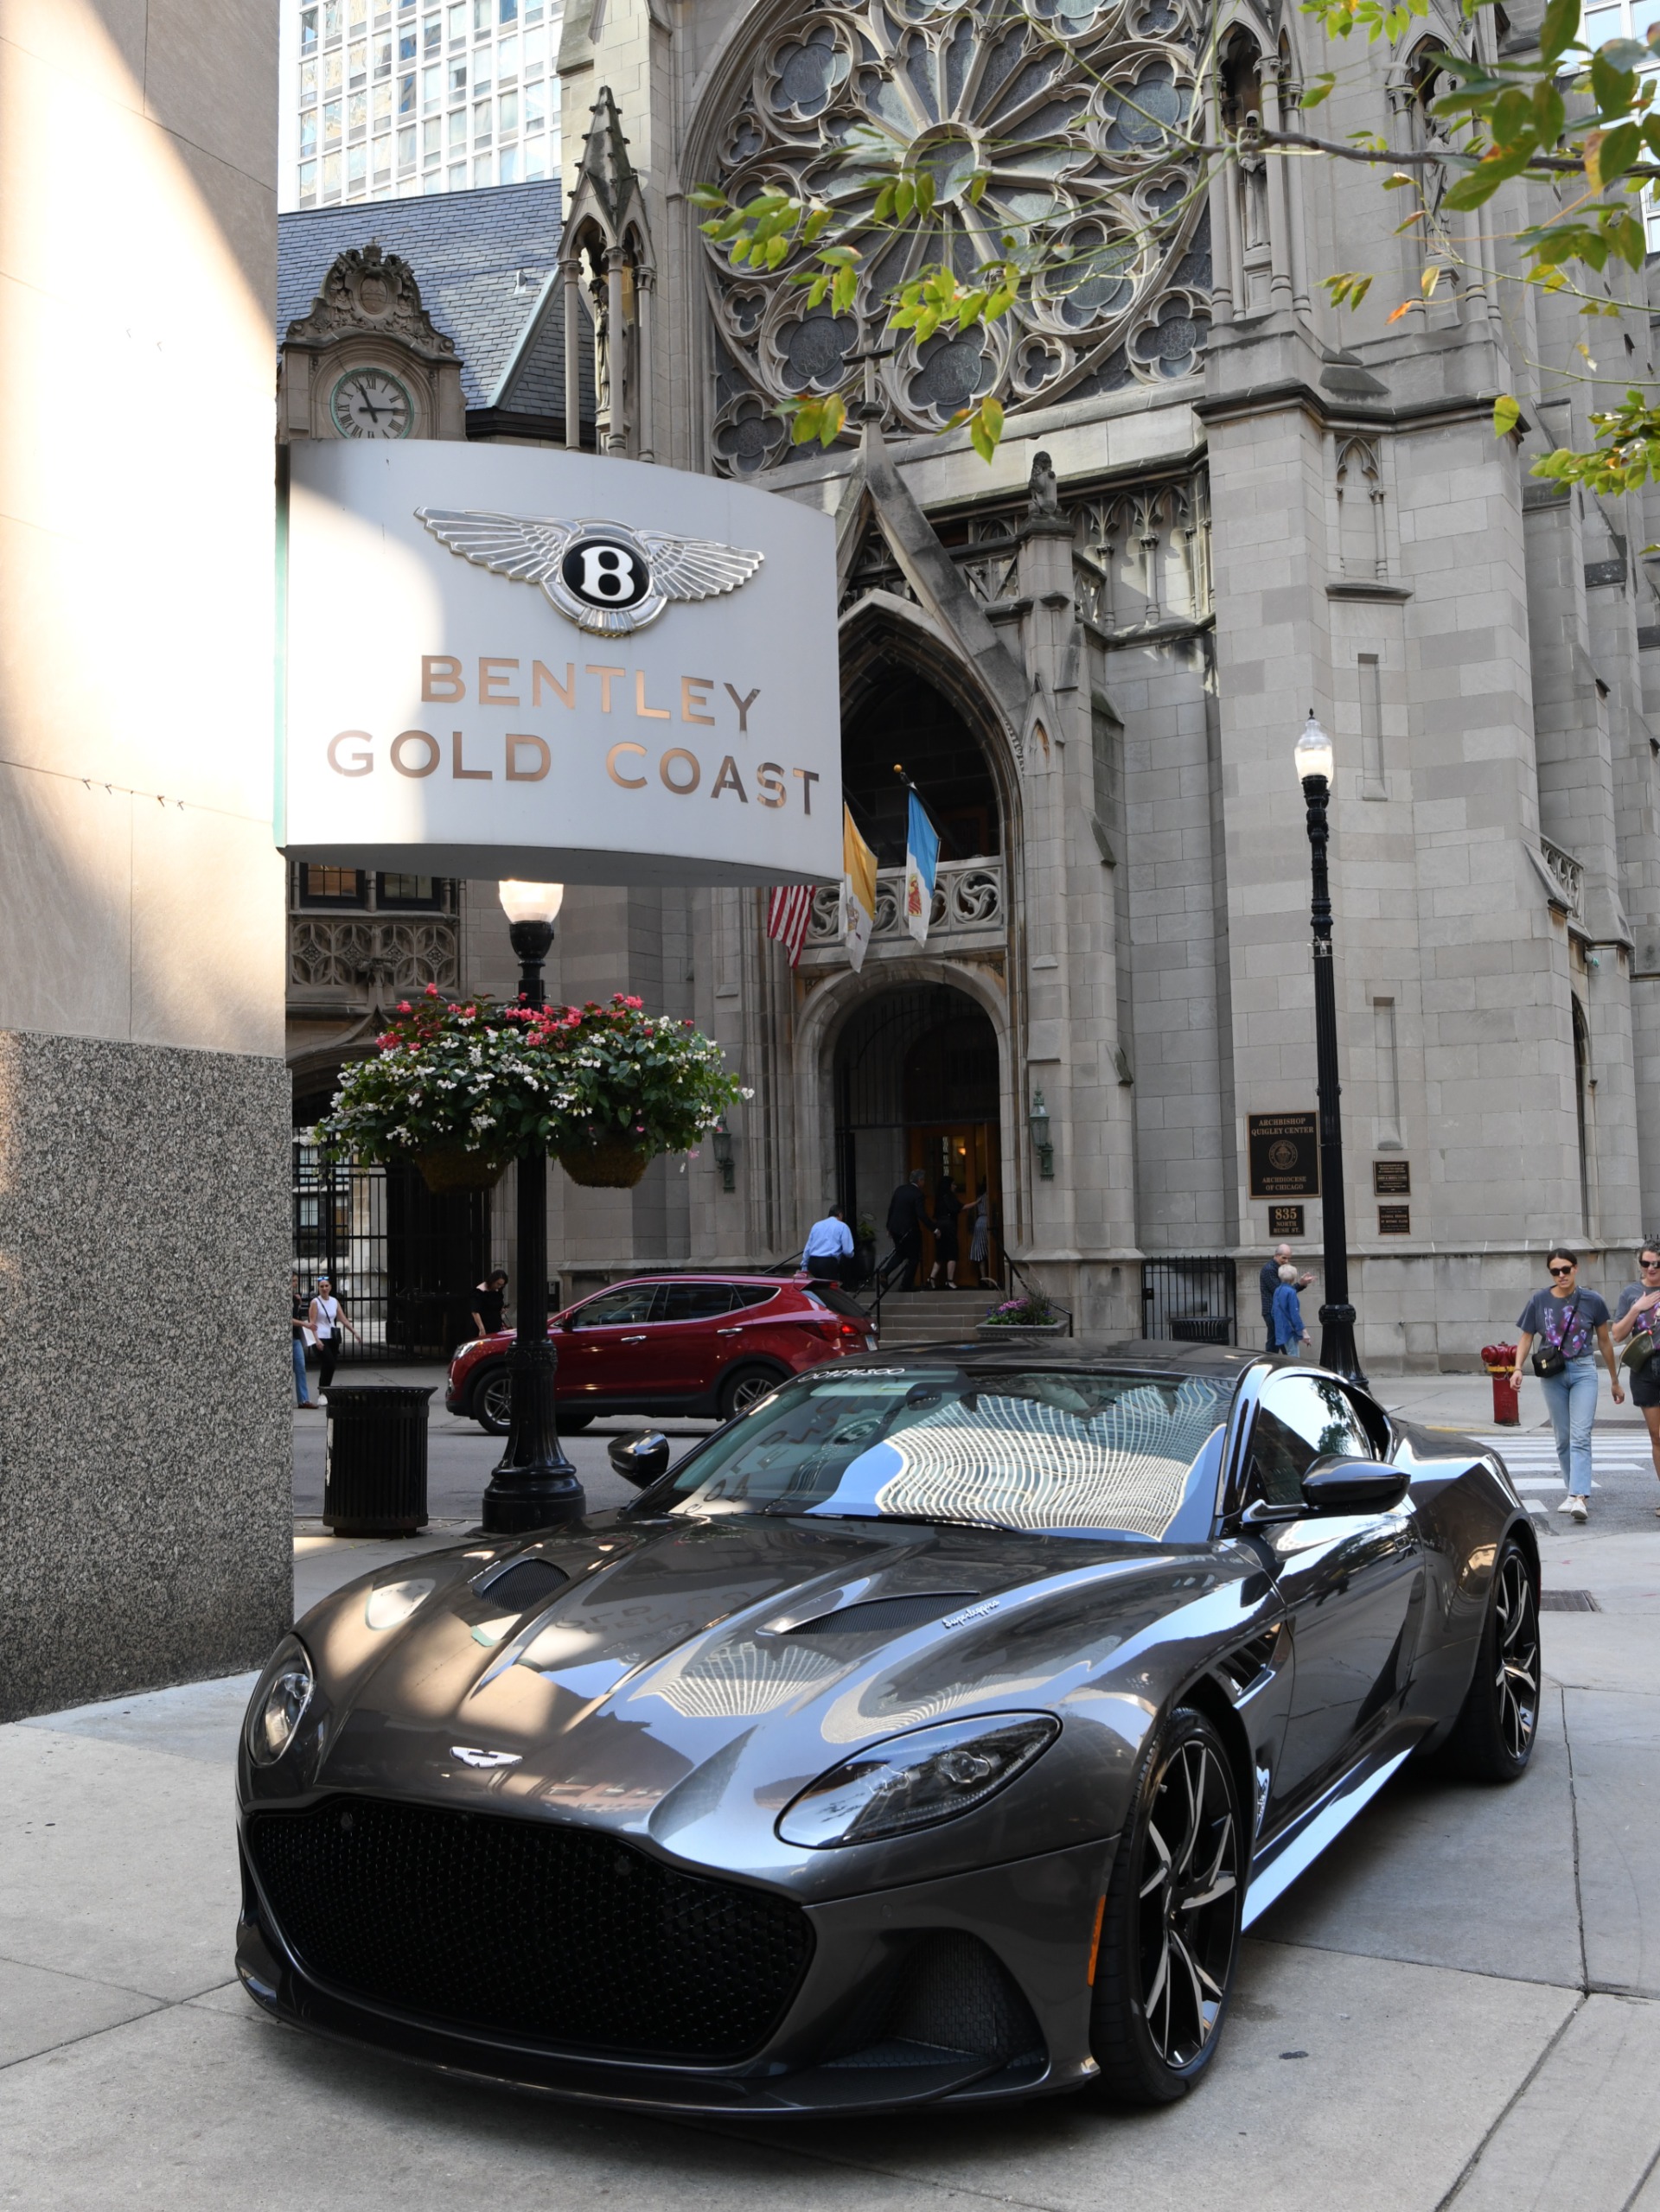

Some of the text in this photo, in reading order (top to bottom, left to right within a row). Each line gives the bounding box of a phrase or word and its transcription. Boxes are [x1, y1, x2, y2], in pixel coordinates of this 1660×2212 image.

[580, 545, 636, 602] B
[421, 654, 762, 733] BENTLEY
[326, 730, 820, 816] GOLD COAST
[1251, 1127, 1284, 1137] QUIGLEY
[1259, 1118, 1306, 1126] ARCHBISHOP
[1275, 1208, 1297, 1221] 835
